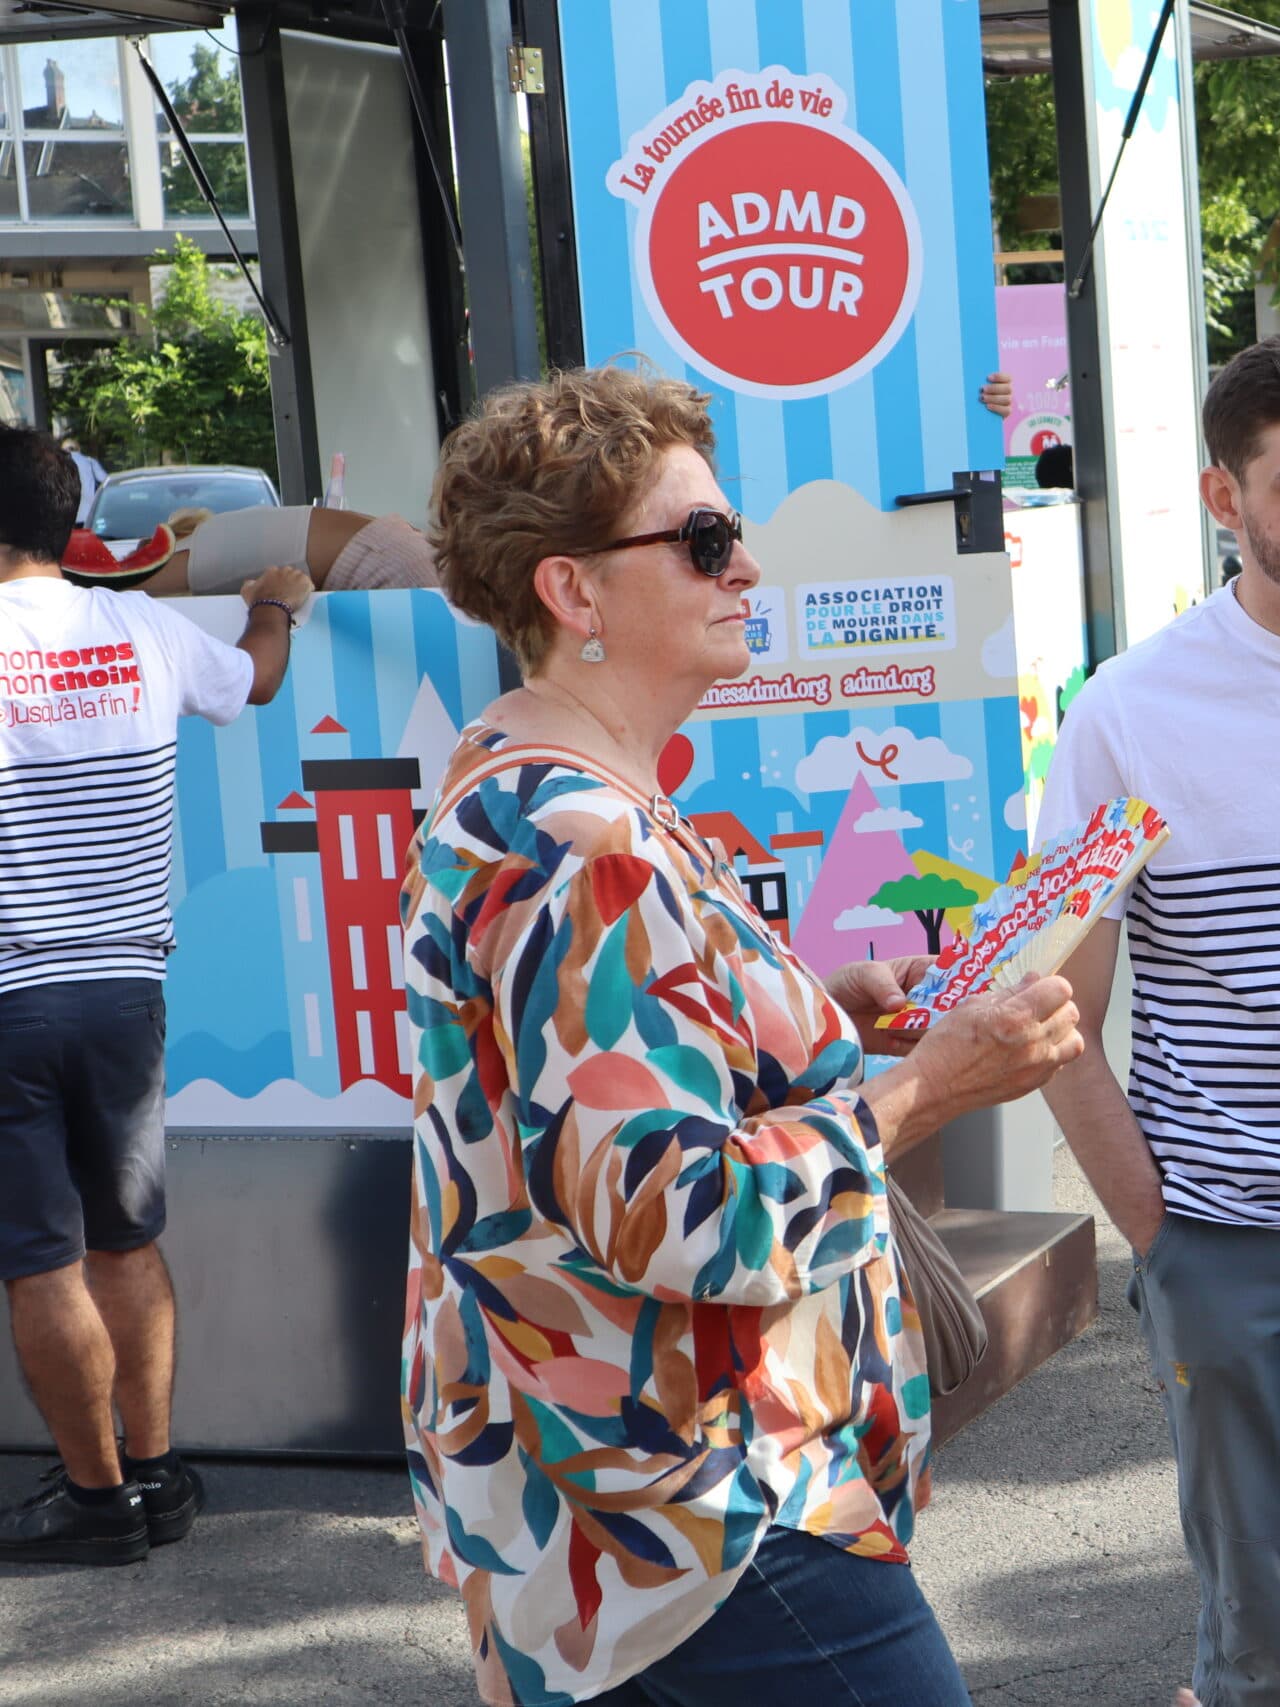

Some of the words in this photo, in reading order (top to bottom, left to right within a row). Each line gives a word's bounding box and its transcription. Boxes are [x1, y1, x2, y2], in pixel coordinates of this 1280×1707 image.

[619, 163, 656, 195] La
[642, 95, 725, 164] tournée
[725, 83, 761, 114] fin
[765, 80, 794, 108] de
[799, 88, 833, 118] vie
[697, 189, 866, 248] ADMD
[698, 266, 865, 319] TOUR
[805, 585, 943, 606] ASSOCIATION
[805, 605, 855, 619] POUR
[861, 603, 882, 615] LE
[889, 599, 943, 613] DROIT
[806, 620, 827, 631] DE
[832, 615, 898, 629] MOURIR
[902, 612, 945, 624] DANS
[807, 632, 836, 647] LA
[45, 642, 135, 669] corps
[50, 665, 141, 691] choix
[844, 667, 933, 695] admd.org
[79, 696, 98, 719] la
